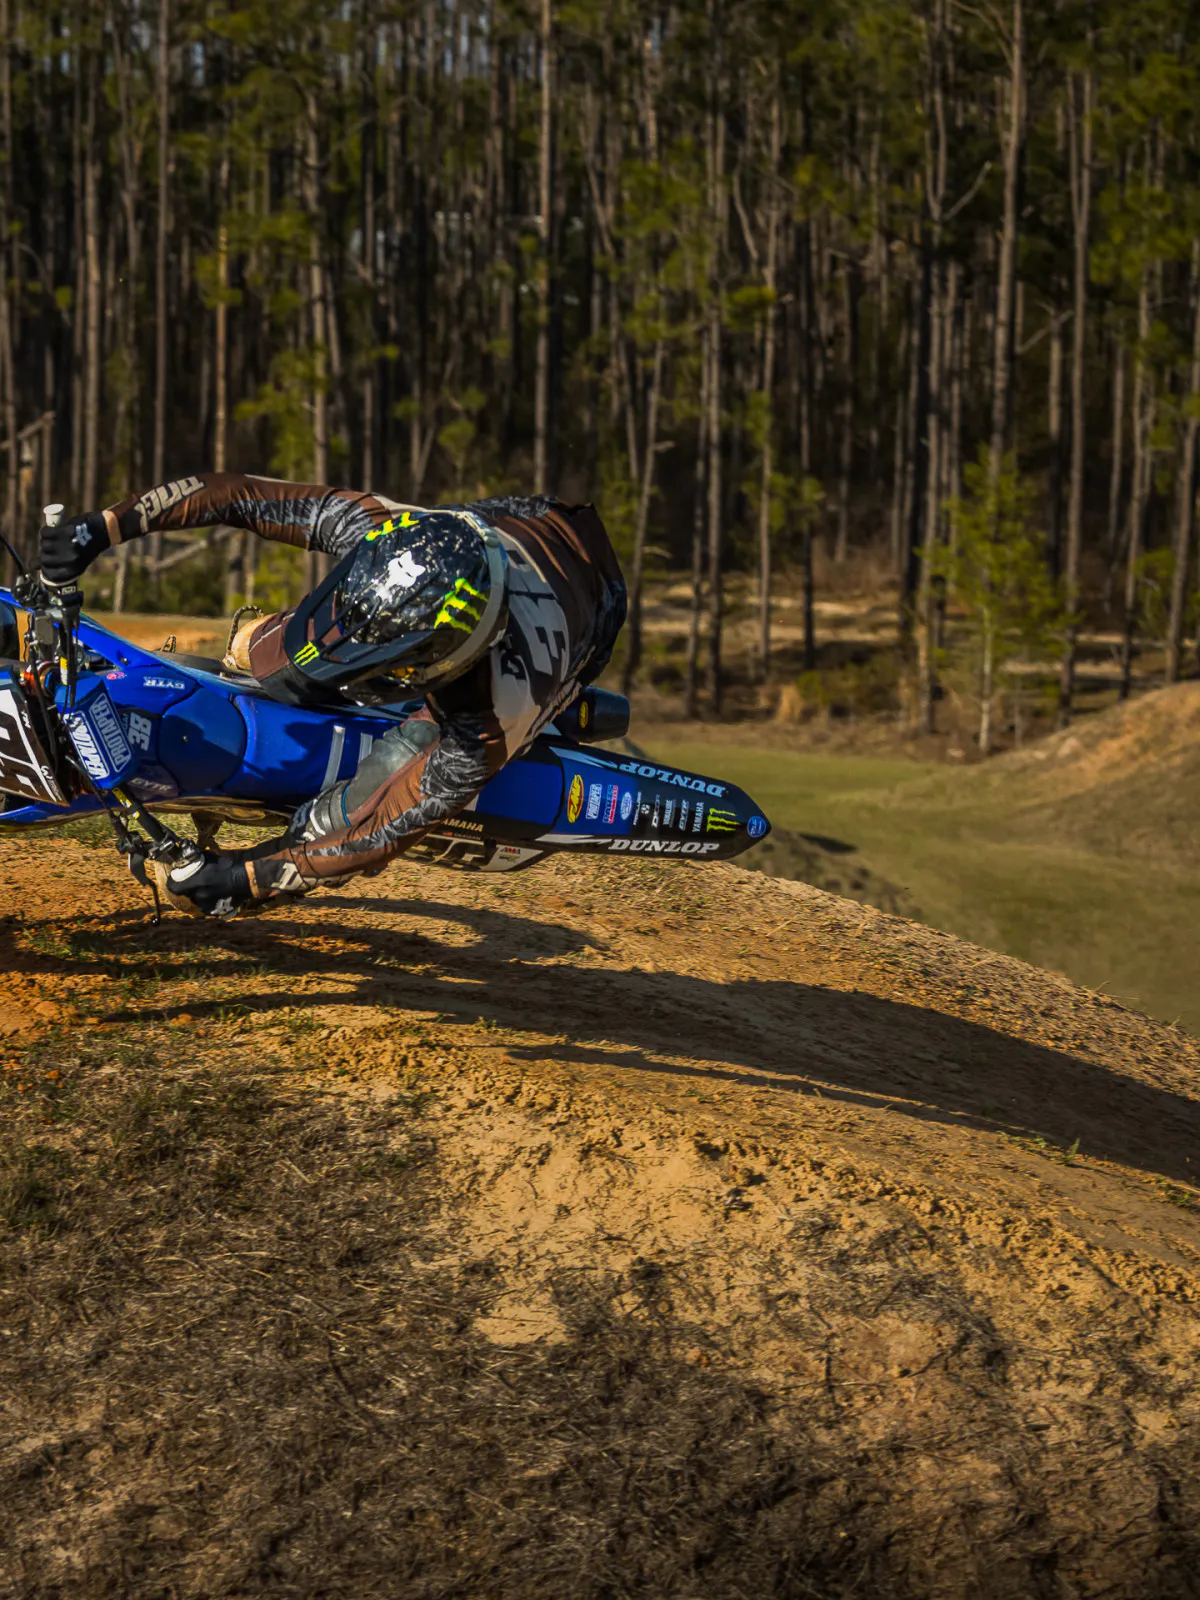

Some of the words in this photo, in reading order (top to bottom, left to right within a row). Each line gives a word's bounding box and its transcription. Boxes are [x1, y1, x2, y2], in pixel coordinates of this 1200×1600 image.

[143, 678, 186, 691] GYTR
[91, 699, 129, 767] PROTAPER
[129, 712, 152, 751] 38
[619, 761, 728, 798] DUNLOP
[567, 774, 584, 823] FMF
[441, 818, 485, 833] AMAHA
[692, 801, 705, 833] YAMAHA
[608, 838, 721, 854] DUNLOP
